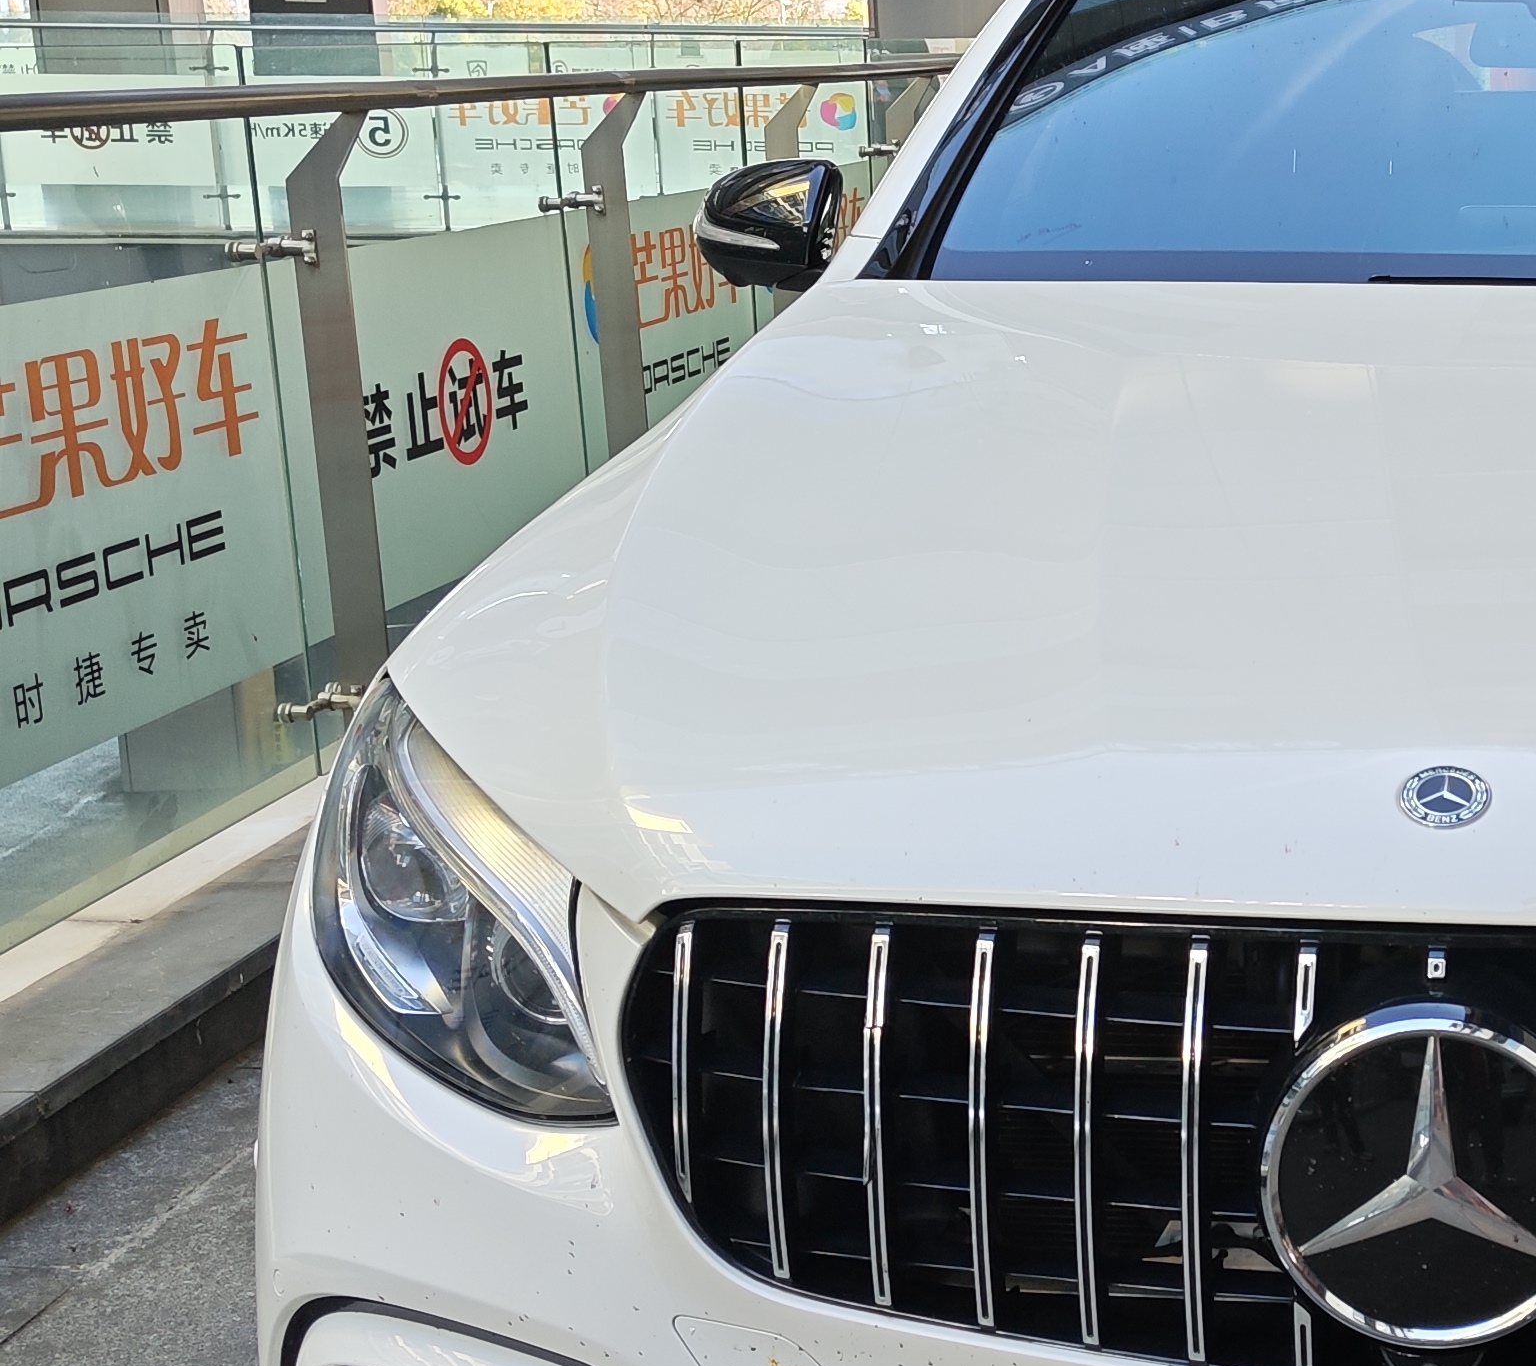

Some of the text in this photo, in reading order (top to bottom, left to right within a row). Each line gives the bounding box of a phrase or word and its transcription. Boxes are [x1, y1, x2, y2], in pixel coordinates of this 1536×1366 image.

[0, 509, 226, 630] RSCHE
[12, 611, 211, 729] 时捷专卖
[1427, 814, 1459, 823] BENZ
